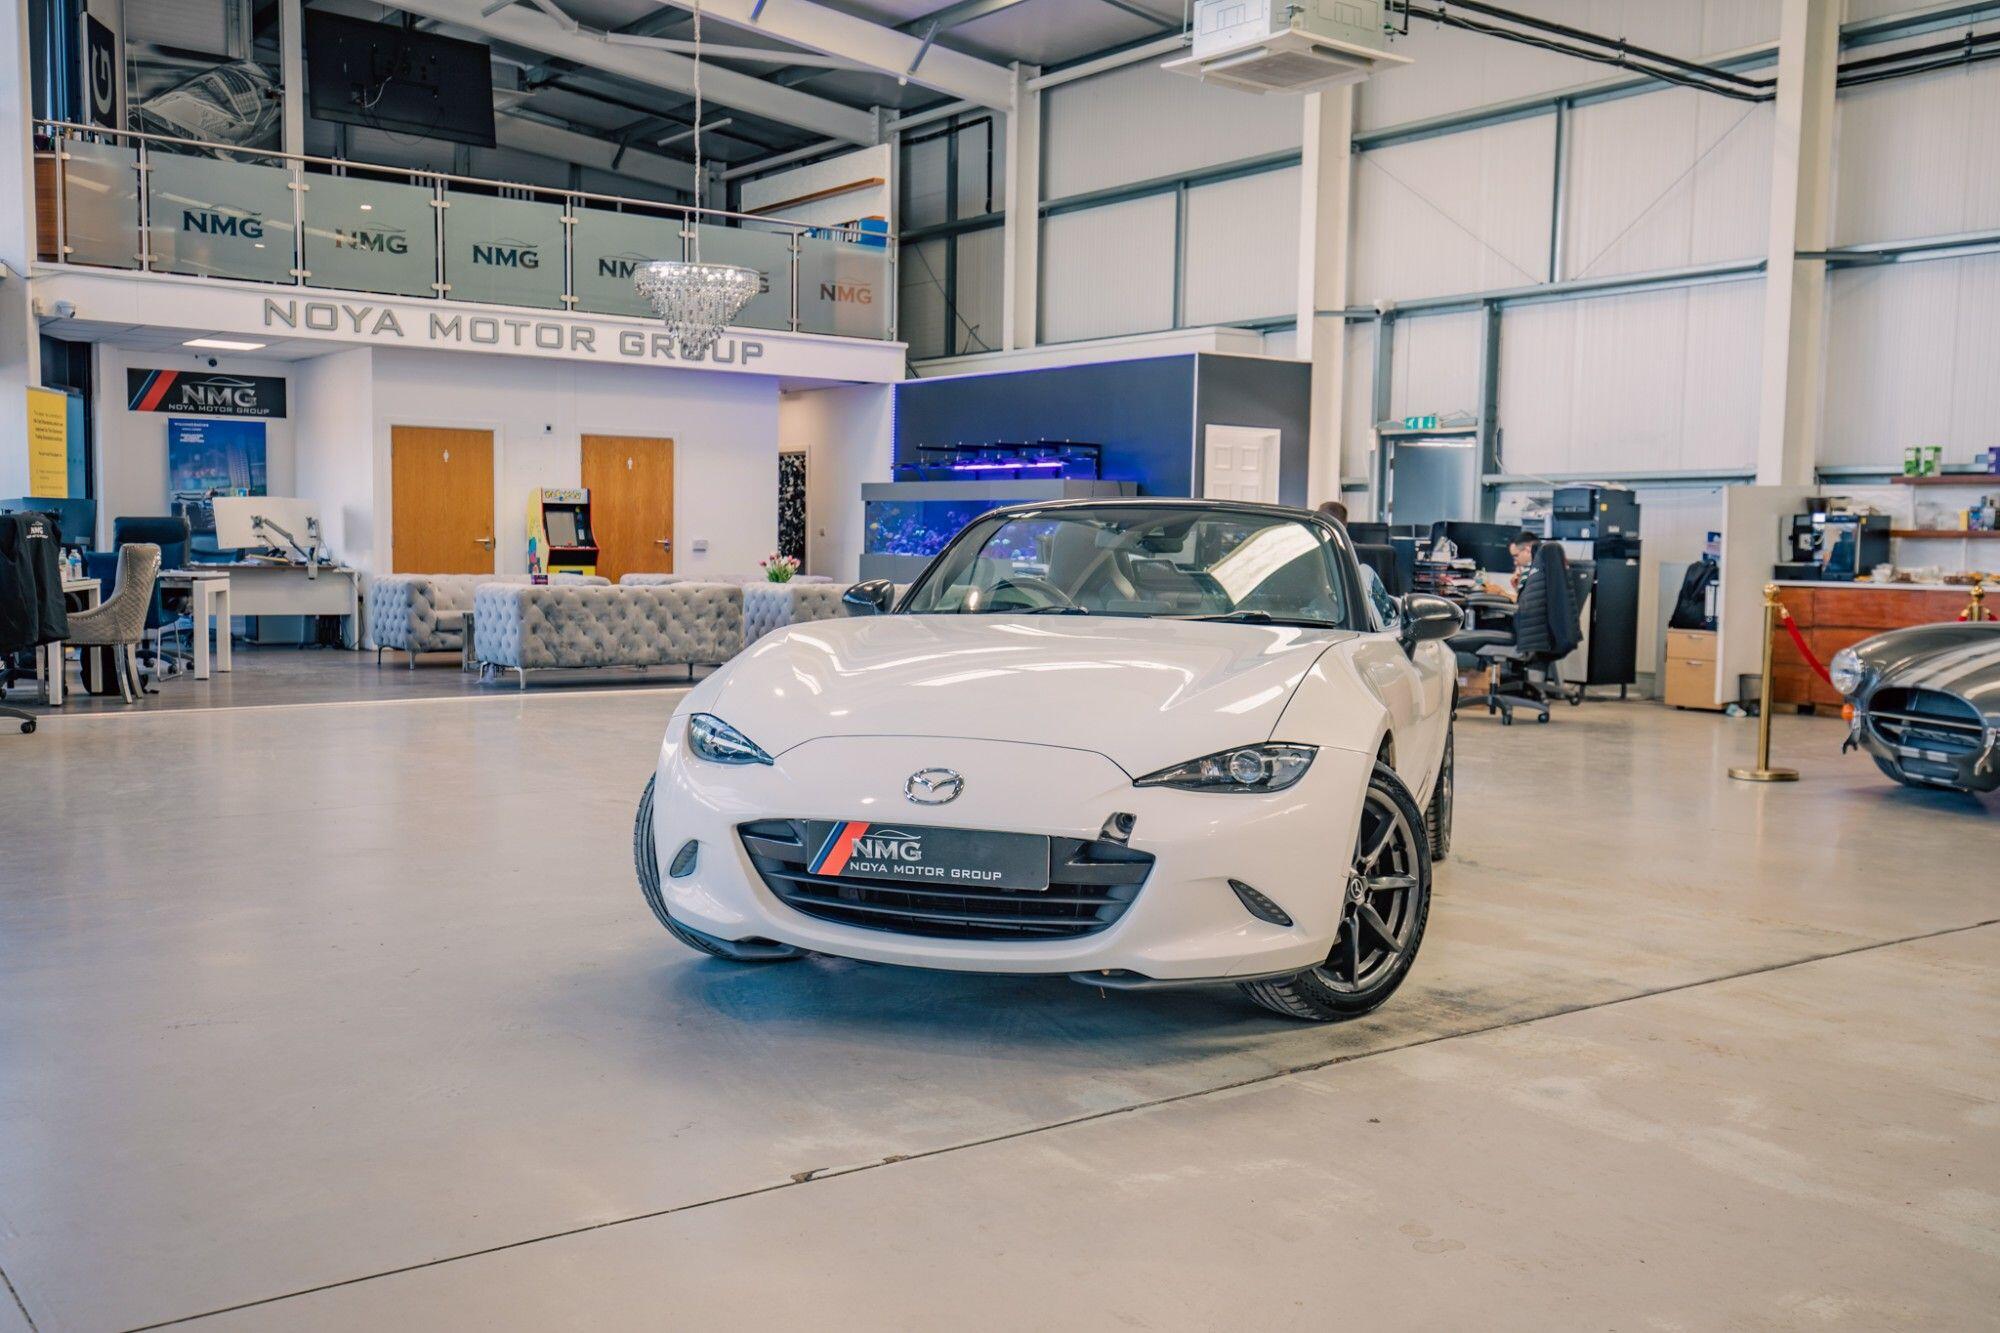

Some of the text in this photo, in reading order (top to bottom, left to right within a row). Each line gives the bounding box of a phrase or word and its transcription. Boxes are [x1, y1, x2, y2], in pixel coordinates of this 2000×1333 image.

[183, 210, 263, 238] NMG
[335, 228, 408, 254] NMG
[473, 245, 539, 269] NMG
[599, 258, 637, 279] NM
[820, 283, 872, 305] NMG
[264, 298, 404, 337] NOYA
[430, 312, 596, 352] MOTOR
[181, 384, 257, 408] NMG
[168, 403, 270, 415] NOYA MOTOR GROUP
[851, 838, 922, 862] NMG
[850, 862, 1002, 881] NOYA MOTOR GROUP
